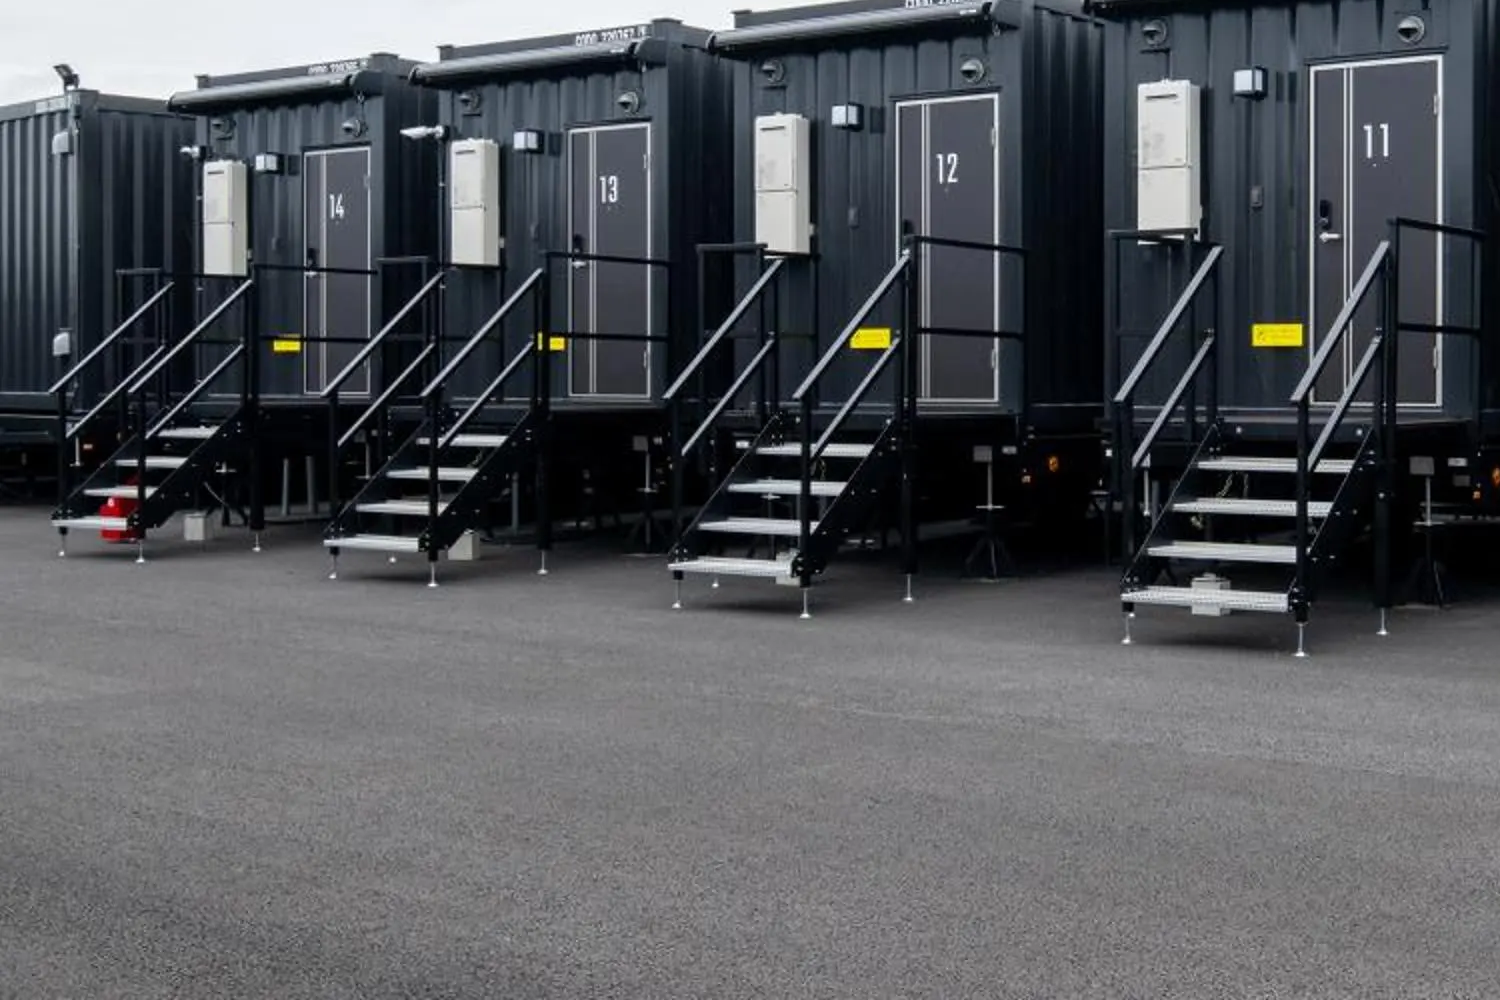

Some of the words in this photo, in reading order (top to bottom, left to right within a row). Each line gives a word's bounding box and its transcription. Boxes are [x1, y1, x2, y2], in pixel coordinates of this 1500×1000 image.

[1362, 122, 1389, 159] 11
[936, 152, 959, 185] 12
[599, 175, 619, 204] 13
[329, 193, 345, 220] 14
